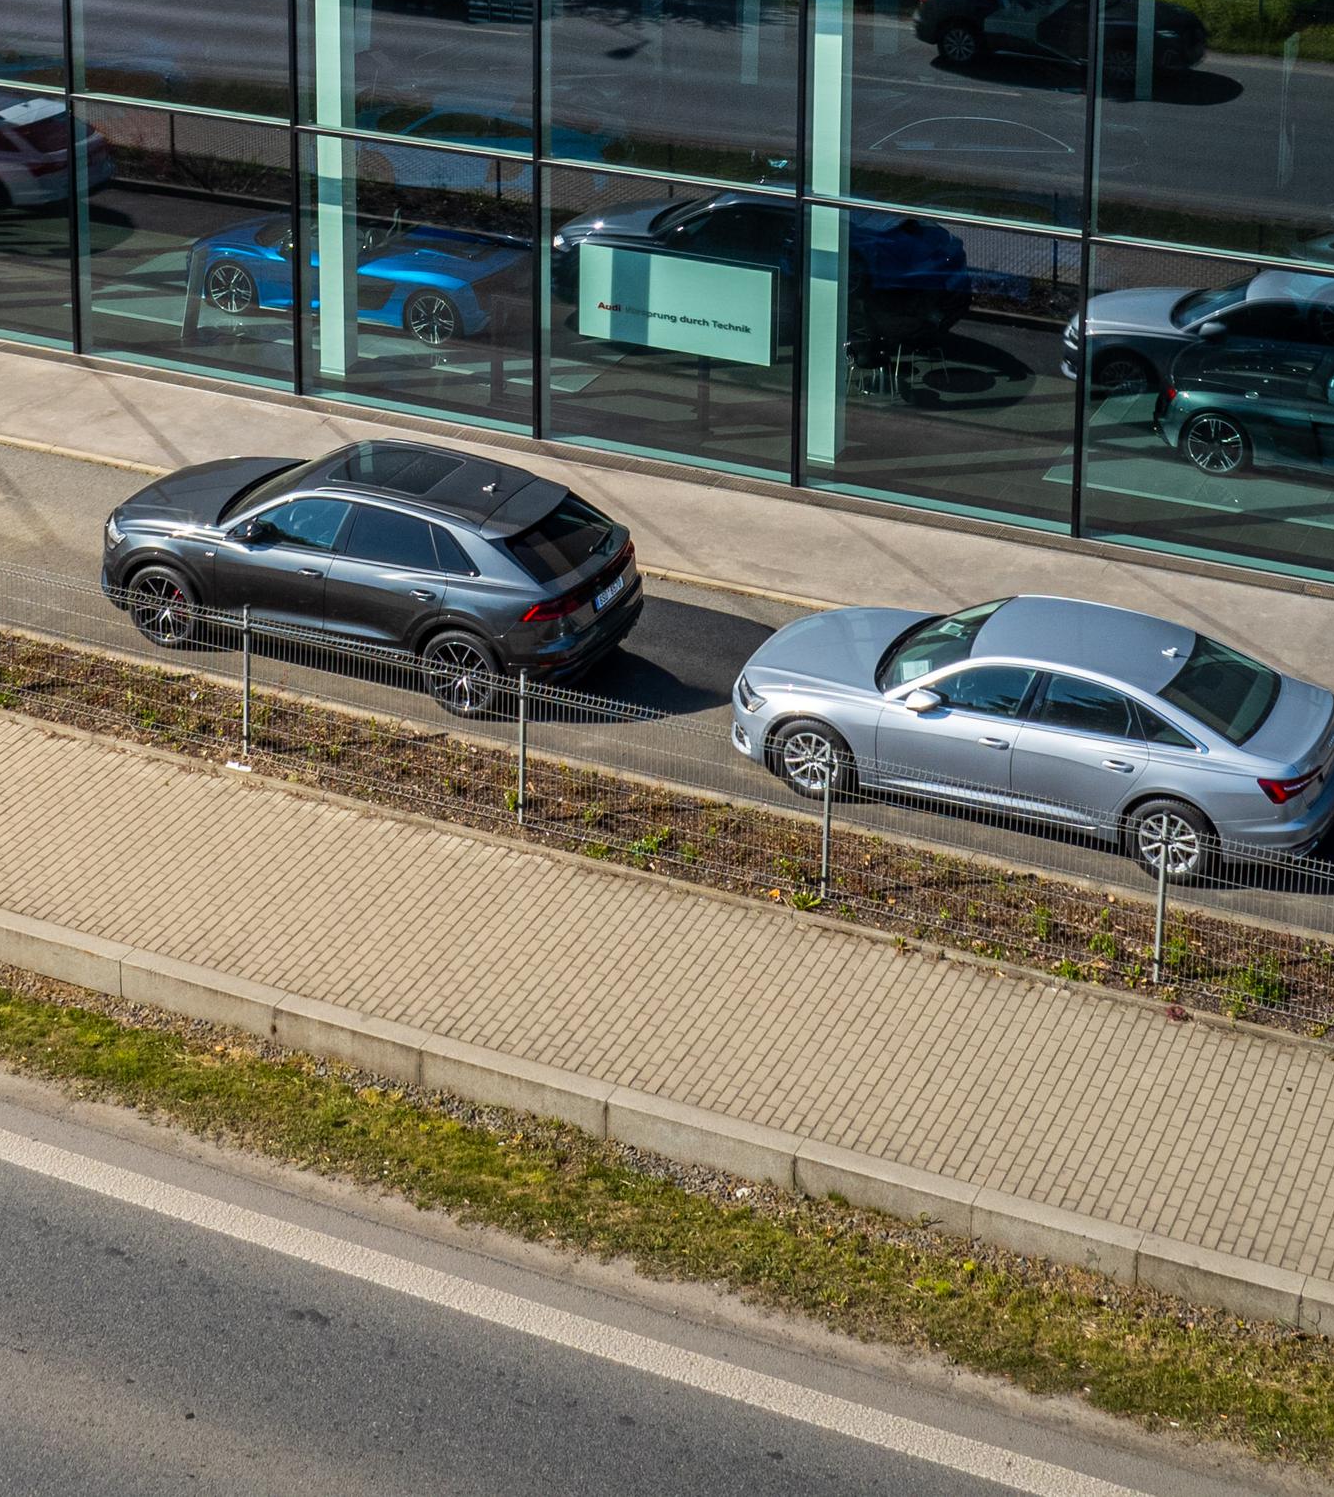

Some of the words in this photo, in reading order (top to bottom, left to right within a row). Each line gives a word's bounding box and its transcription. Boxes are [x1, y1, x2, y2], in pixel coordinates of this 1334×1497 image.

[597, 301, 622, 312] Audi
[625, 306, 678, 323] Vorsprung
[680, 315, 710, 327] durch
[712, 319, 752, 334] Technik
